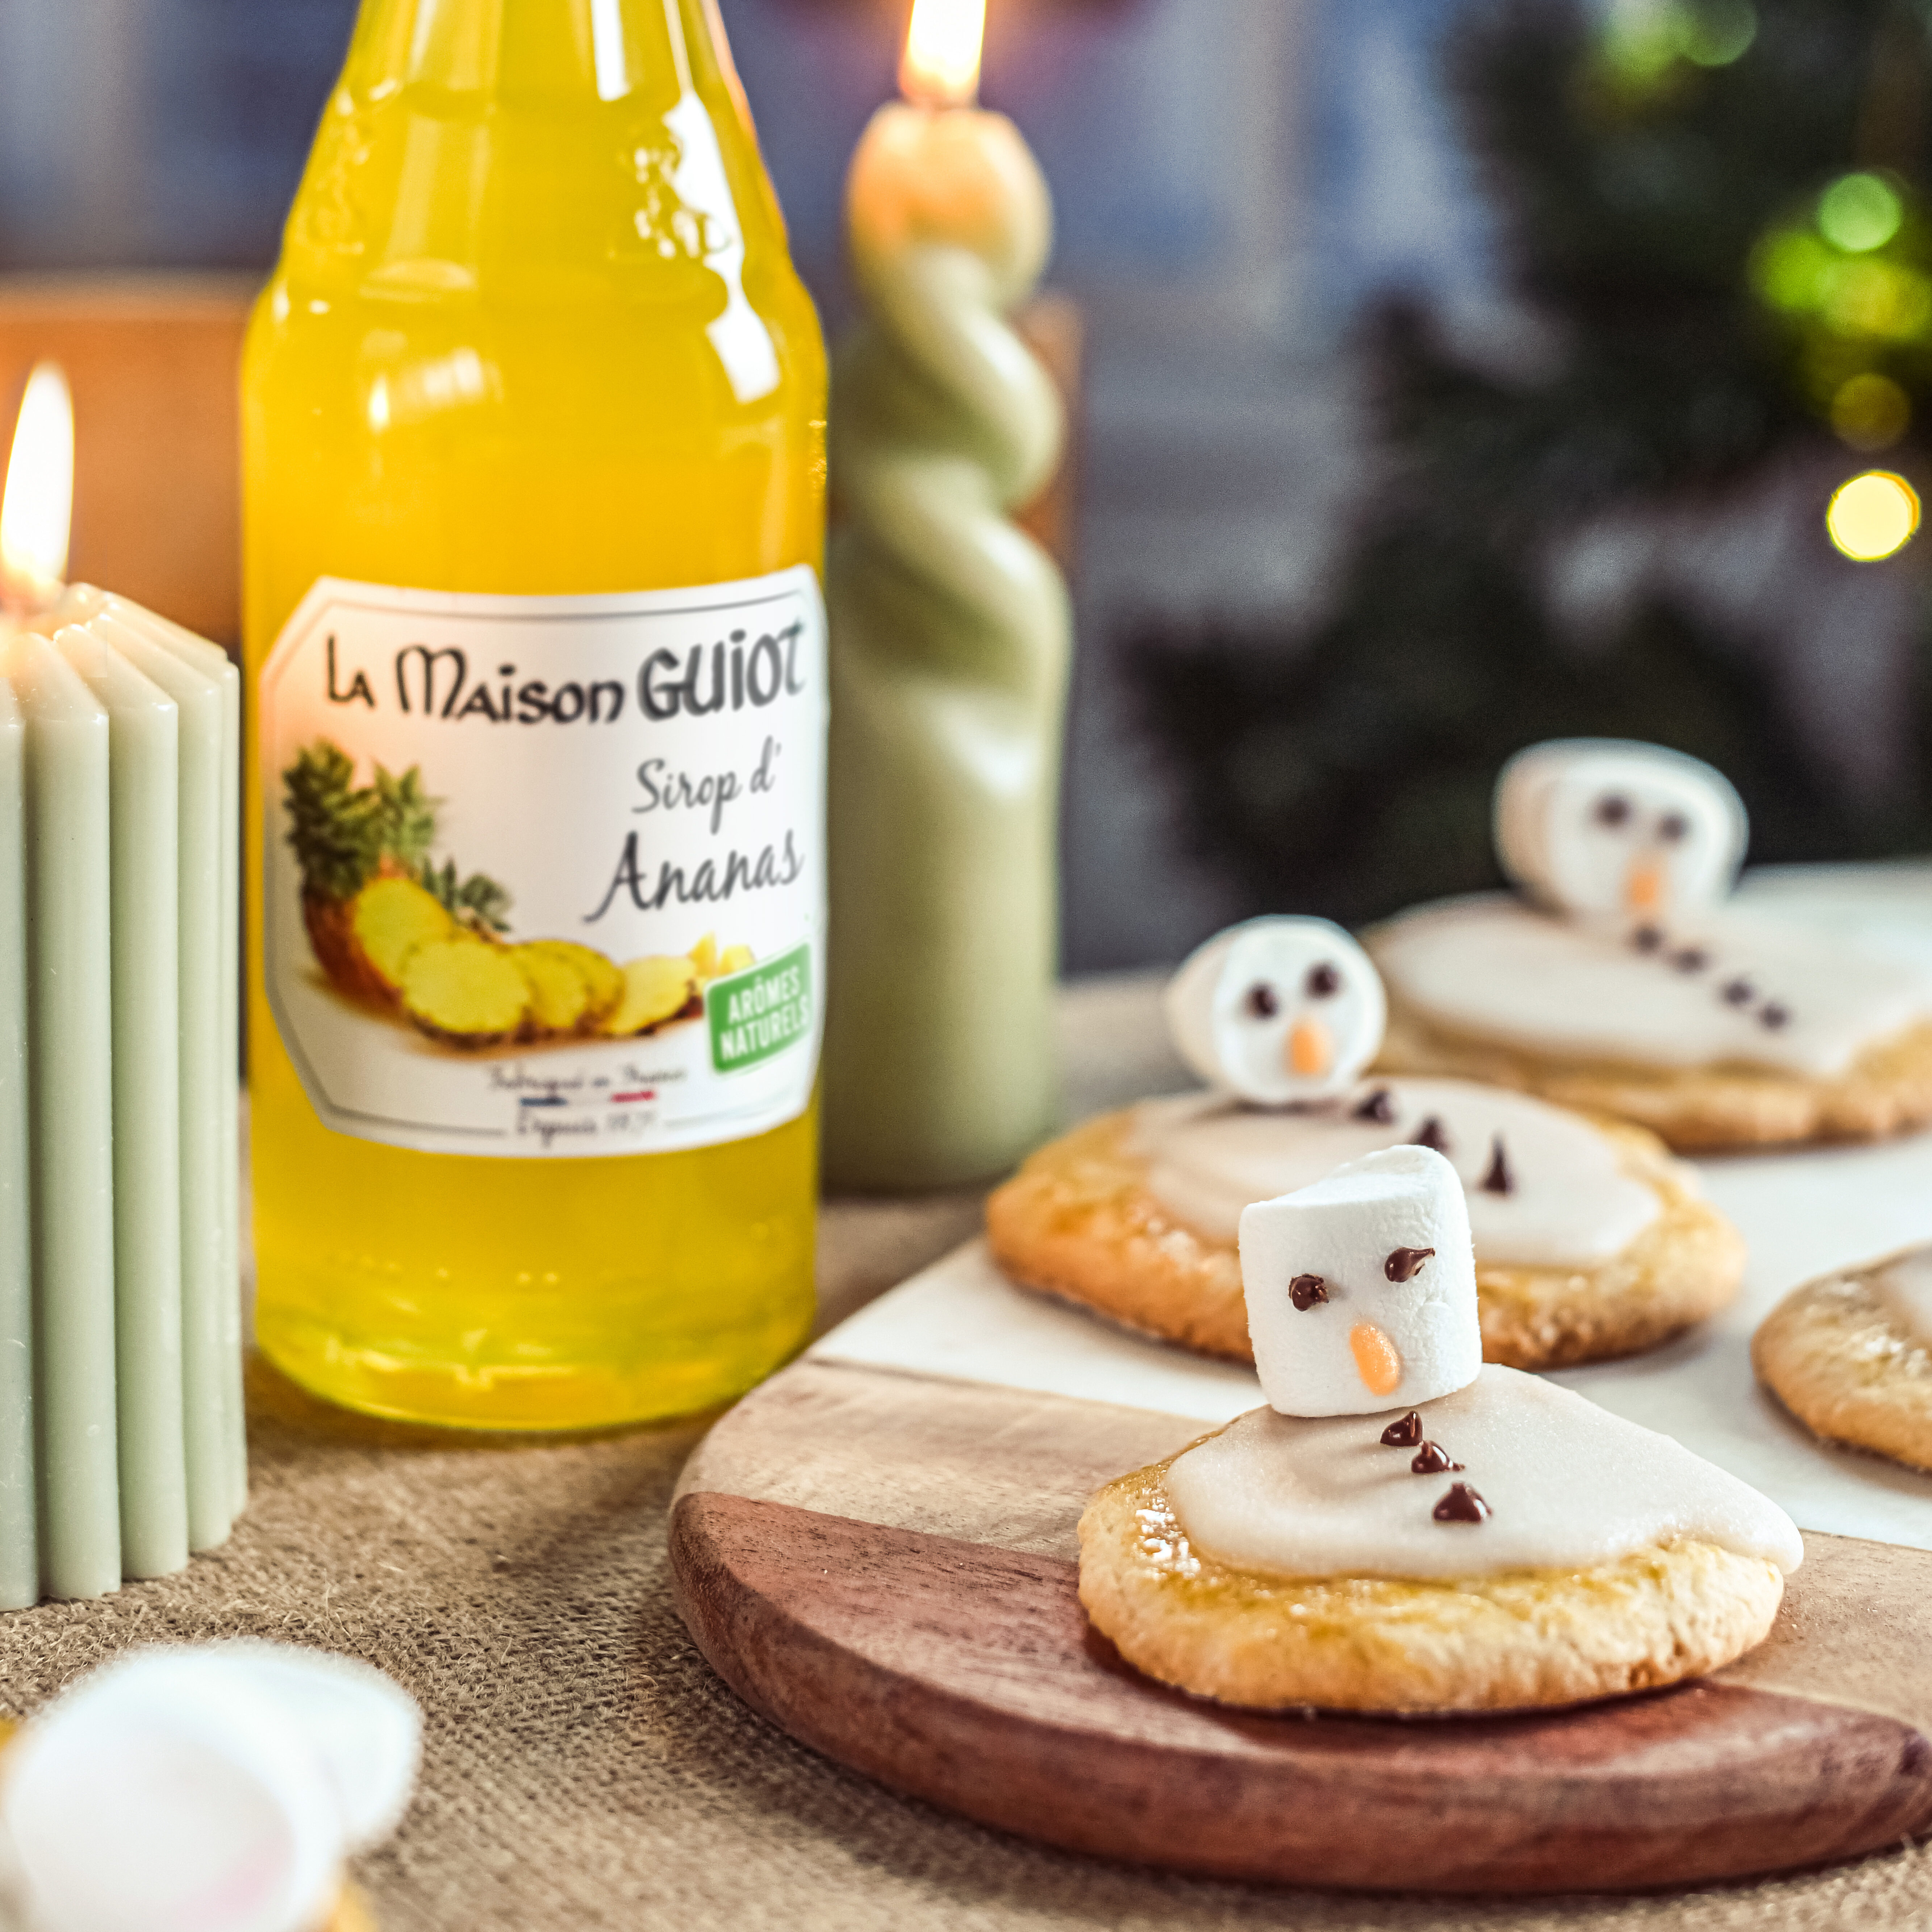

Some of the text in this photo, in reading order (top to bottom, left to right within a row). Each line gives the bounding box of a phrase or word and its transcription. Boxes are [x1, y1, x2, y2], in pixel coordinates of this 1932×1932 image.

[631, 735, 782, 835] Sirop d'
[583, 828, 805, 925] Ananas
[721, 995, 809, 1060] NATURELS
[729, 965, 799, 1023] ARÔMES
